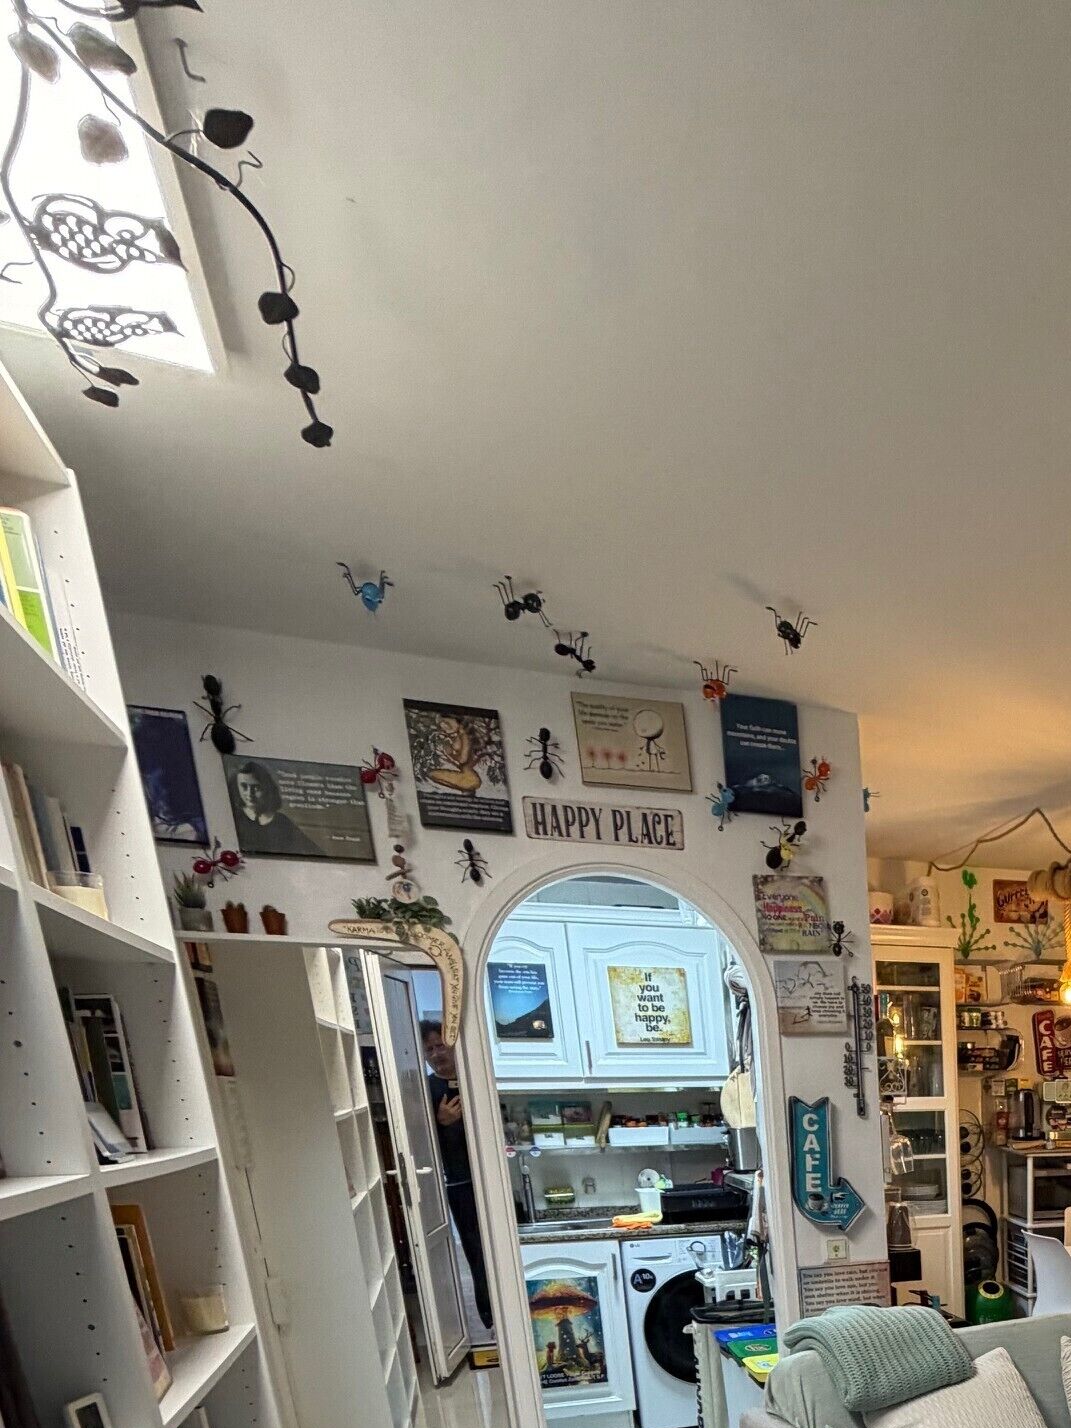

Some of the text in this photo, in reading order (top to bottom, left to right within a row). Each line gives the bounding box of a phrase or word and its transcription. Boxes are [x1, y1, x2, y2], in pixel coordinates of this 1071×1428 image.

[531, 802, 602, 841] HAPPY
[611, 809, 676, 847] PLACE
[644, 972, 653, 982] If
[639, 984, 660, 994] you
[637, 994, 664, 1002] want
[638, 1003, 665, 1012] to be
[634, 1013, 671, 1025] happy,
[645, 1023, 663, 1032] be.
[1039, 1020, 1053, 1072] CAFE
[802, 1113, 822, 1192] CAFE
